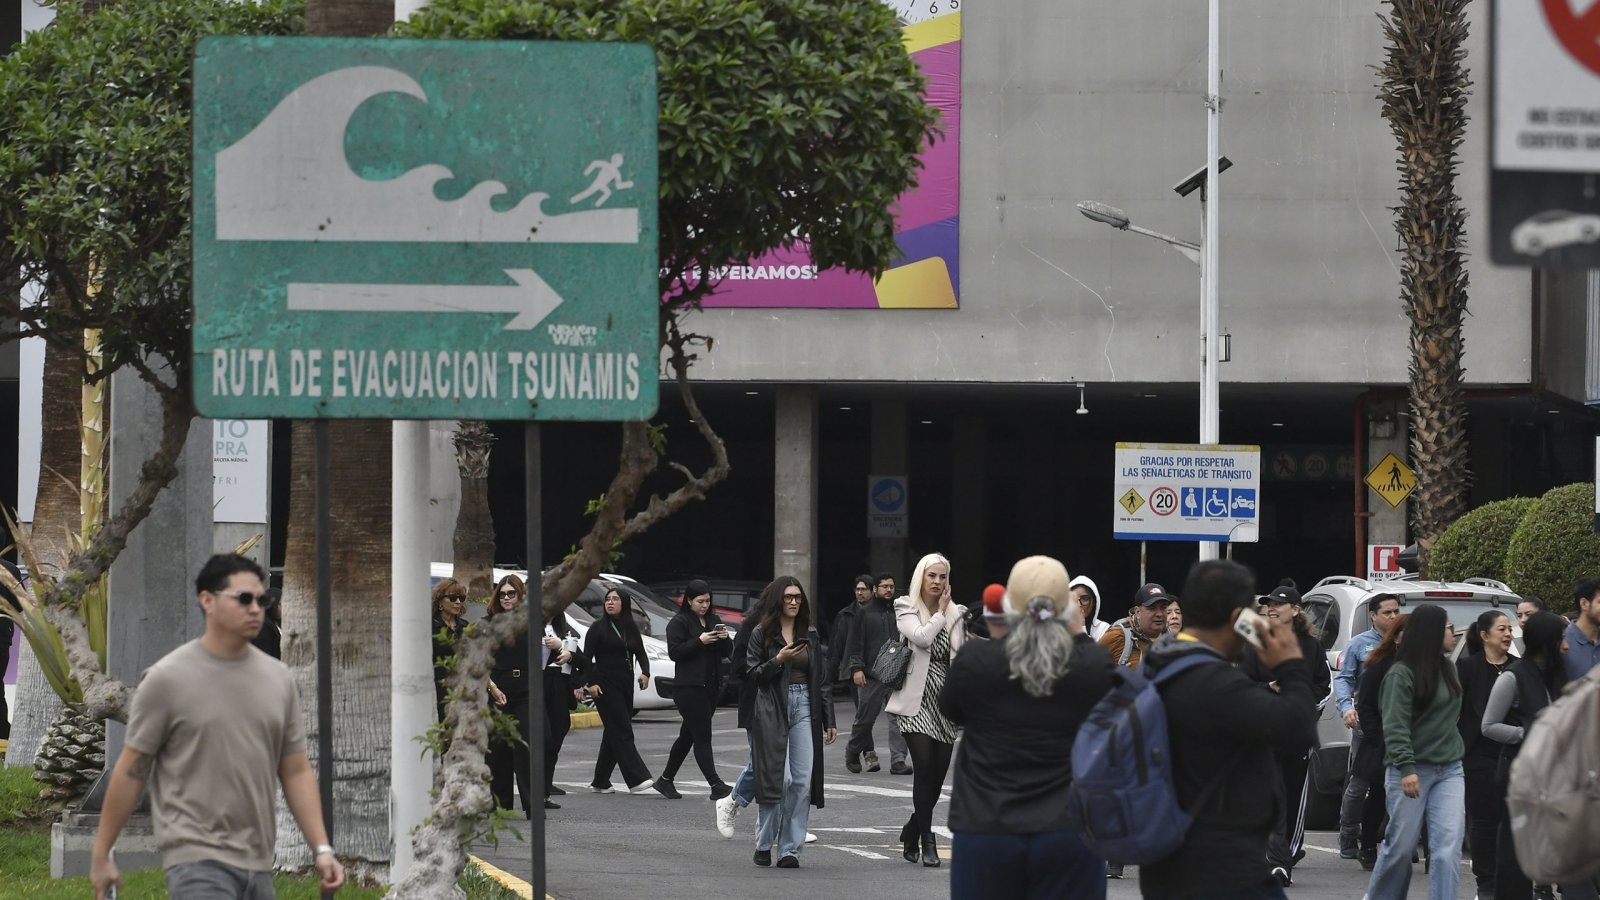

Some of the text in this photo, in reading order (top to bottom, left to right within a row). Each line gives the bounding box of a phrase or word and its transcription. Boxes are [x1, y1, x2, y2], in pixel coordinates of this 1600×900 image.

[929, 1, 938, 14] 6
[212, 349, 640, 400] RUTA DE EVACUACION TSUNAMIS
[215, 441, 248, 456] PRA
[1140, 456, 1234, 467] GRACIAS POR RESPETAR
[1122, 468, 1139, 477] LAS
[1197, 469, 1208, 478] DE
[1156, 493, 1173, 508] 20
